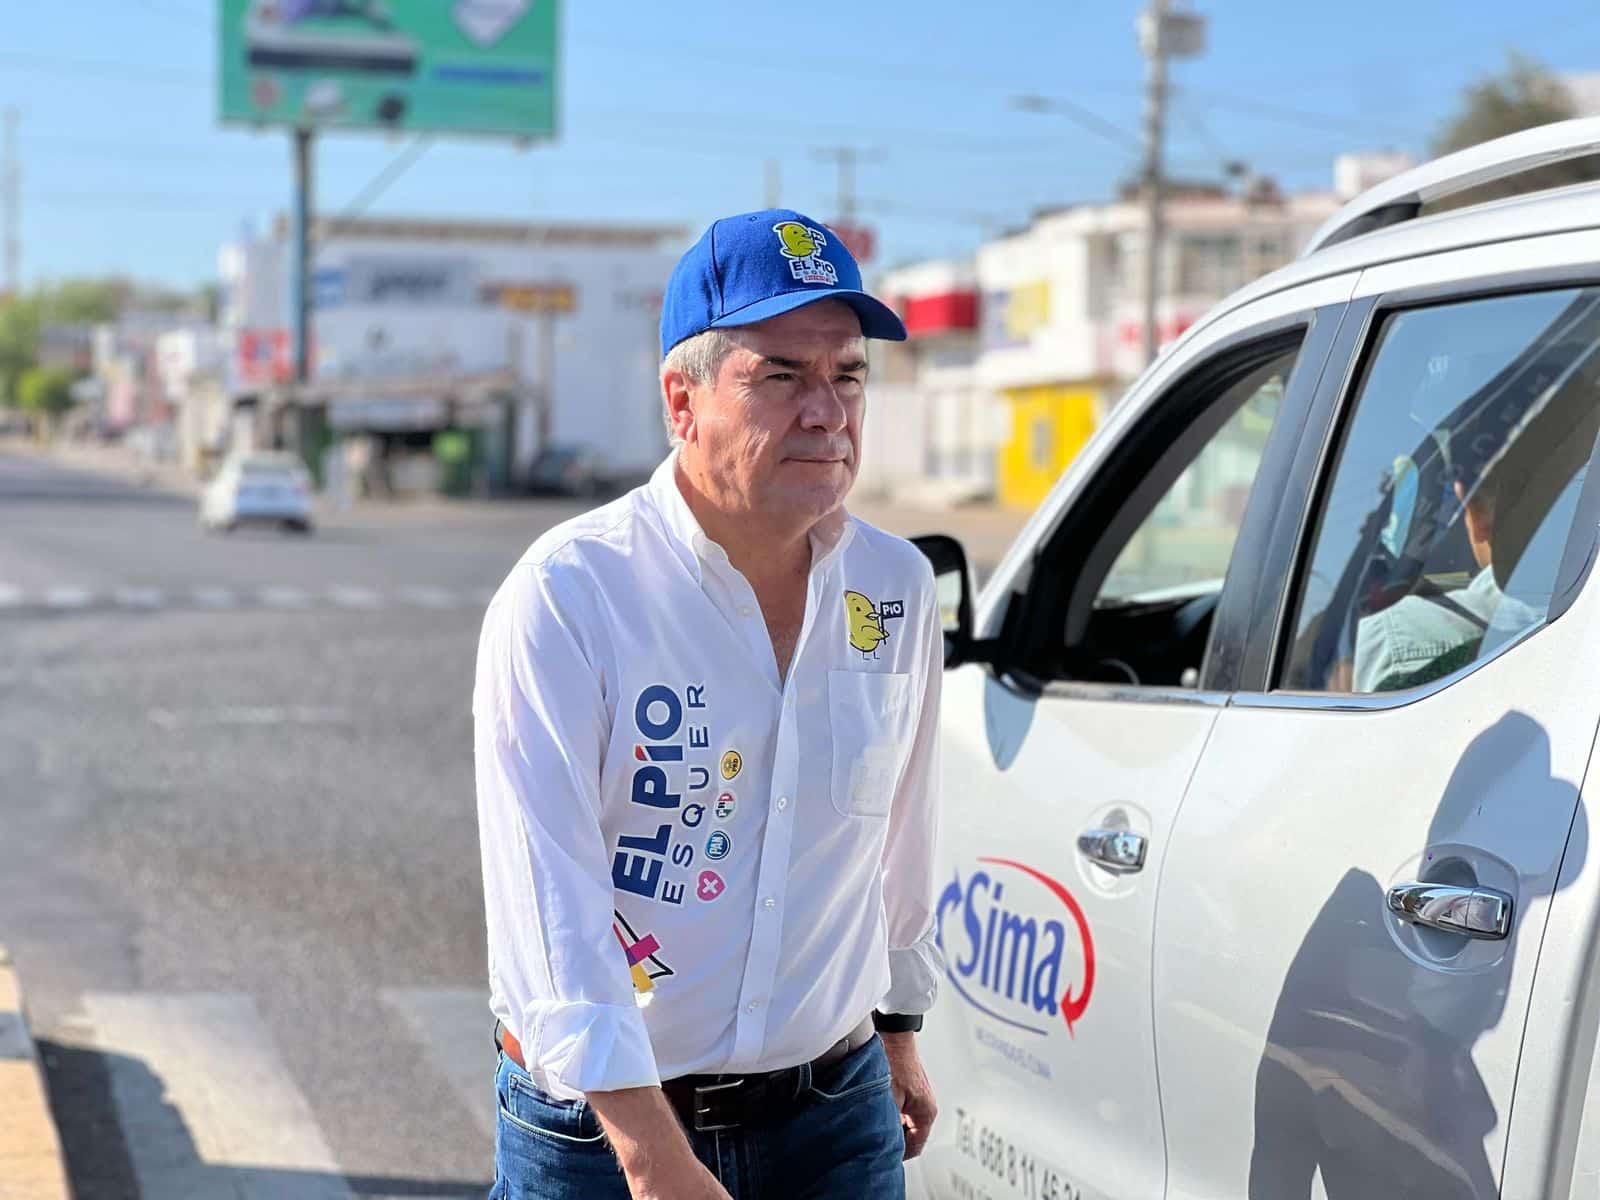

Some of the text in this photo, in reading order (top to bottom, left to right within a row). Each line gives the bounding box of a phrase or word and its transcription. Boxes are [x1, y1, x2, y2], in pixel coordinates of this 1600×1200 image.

[792, 261, 811, 271] EL
[661, 685, 710, 904] ESQUER
[611, 825, 673, 899] EL
[709, 836, 724, 855] PAN
[957, 871, 1066, 1017] Sima
